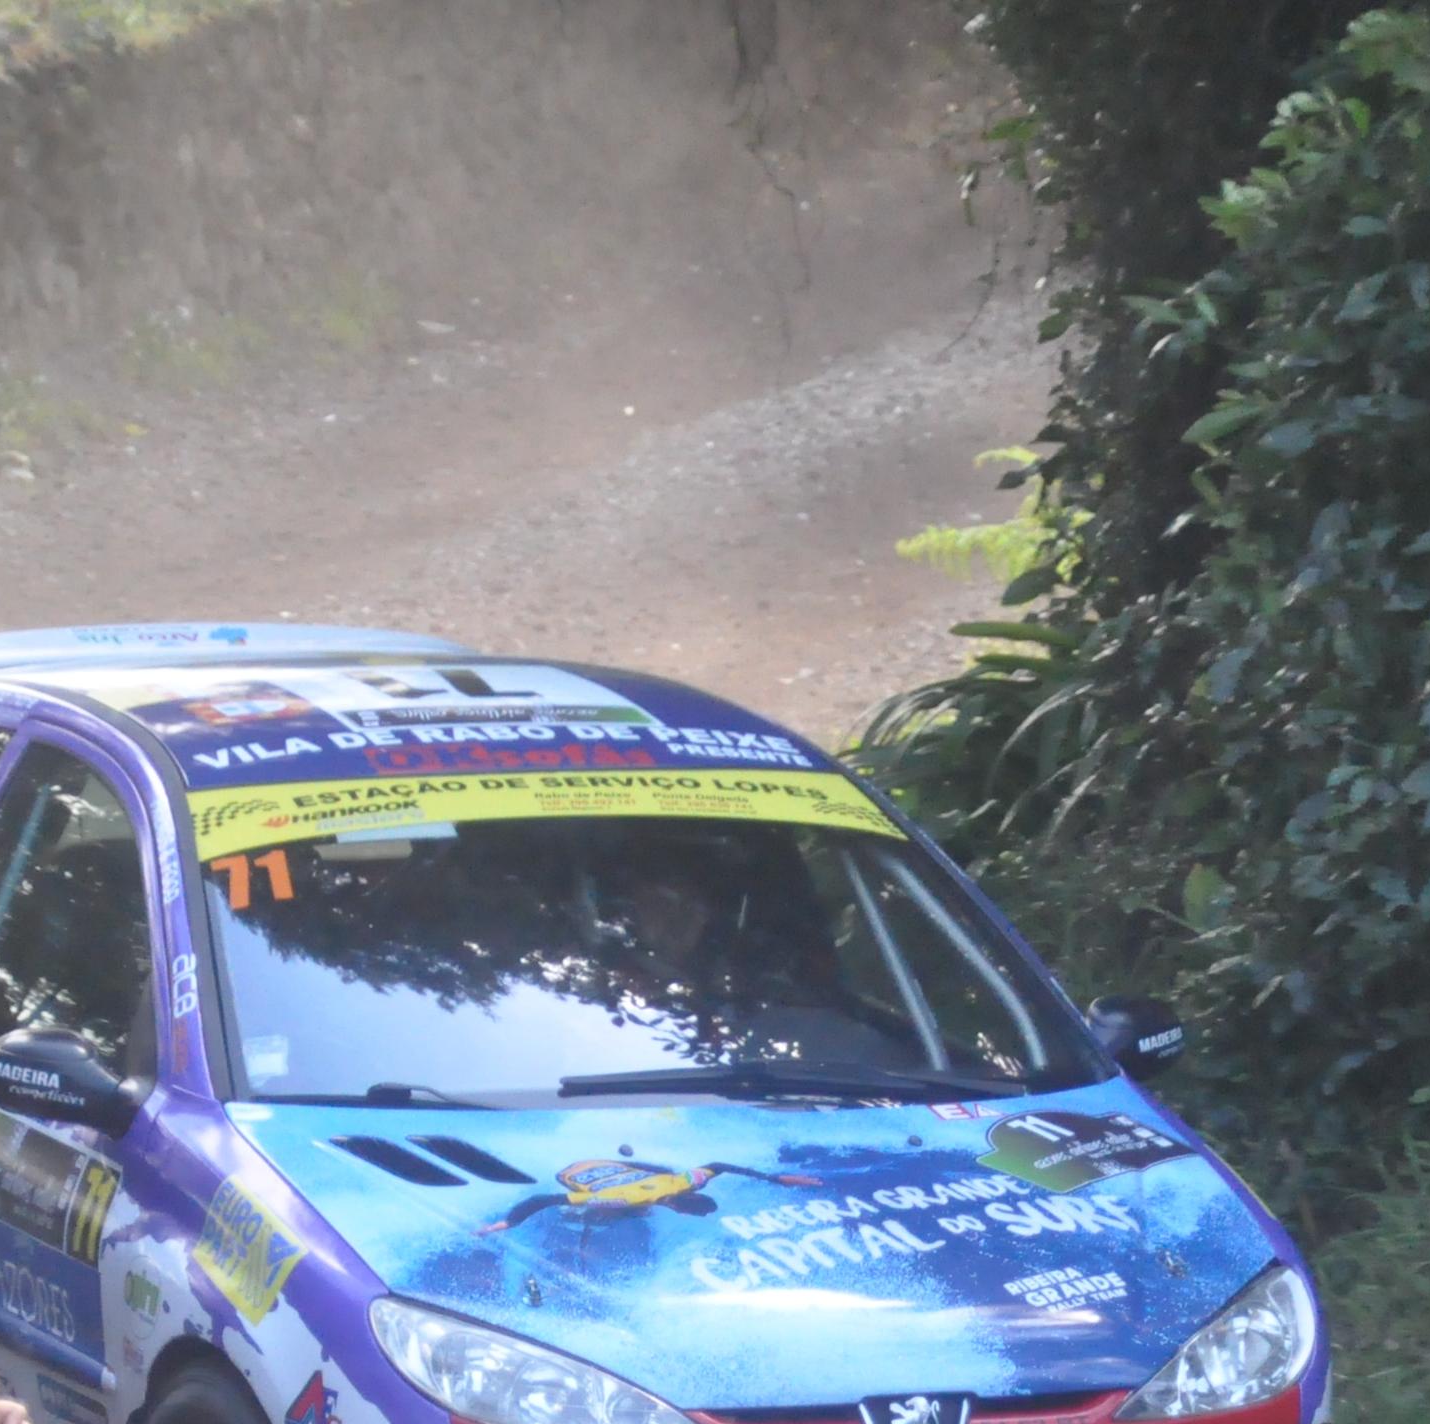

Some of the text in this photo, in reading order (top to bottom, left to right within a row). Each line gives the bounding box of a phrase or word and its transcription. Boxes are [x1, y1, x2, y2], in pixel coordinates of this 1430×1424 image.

[193, 725, 800, 769] VILA DE RABO DE PEIXE
[666, 742, 813, 767] PRESENTE
[292, 775, 828, 809] ESTAÇÃO DE SERVIÇO LOPES
[211, 850, 294, 910] 71
[211, 1180, 264, 1247] EURO
[721, 1174, 1031, 1240] RIBEIRA GRANDE
[690, 1194, 1141, 1293] CAPITAL DO SURF
[1003, 1266, 1083, 1298] RIBEIRA
[1025, 1272, 1127, 1308] GRANDE
[1091, 1287, 1128, 1302] TEAM
